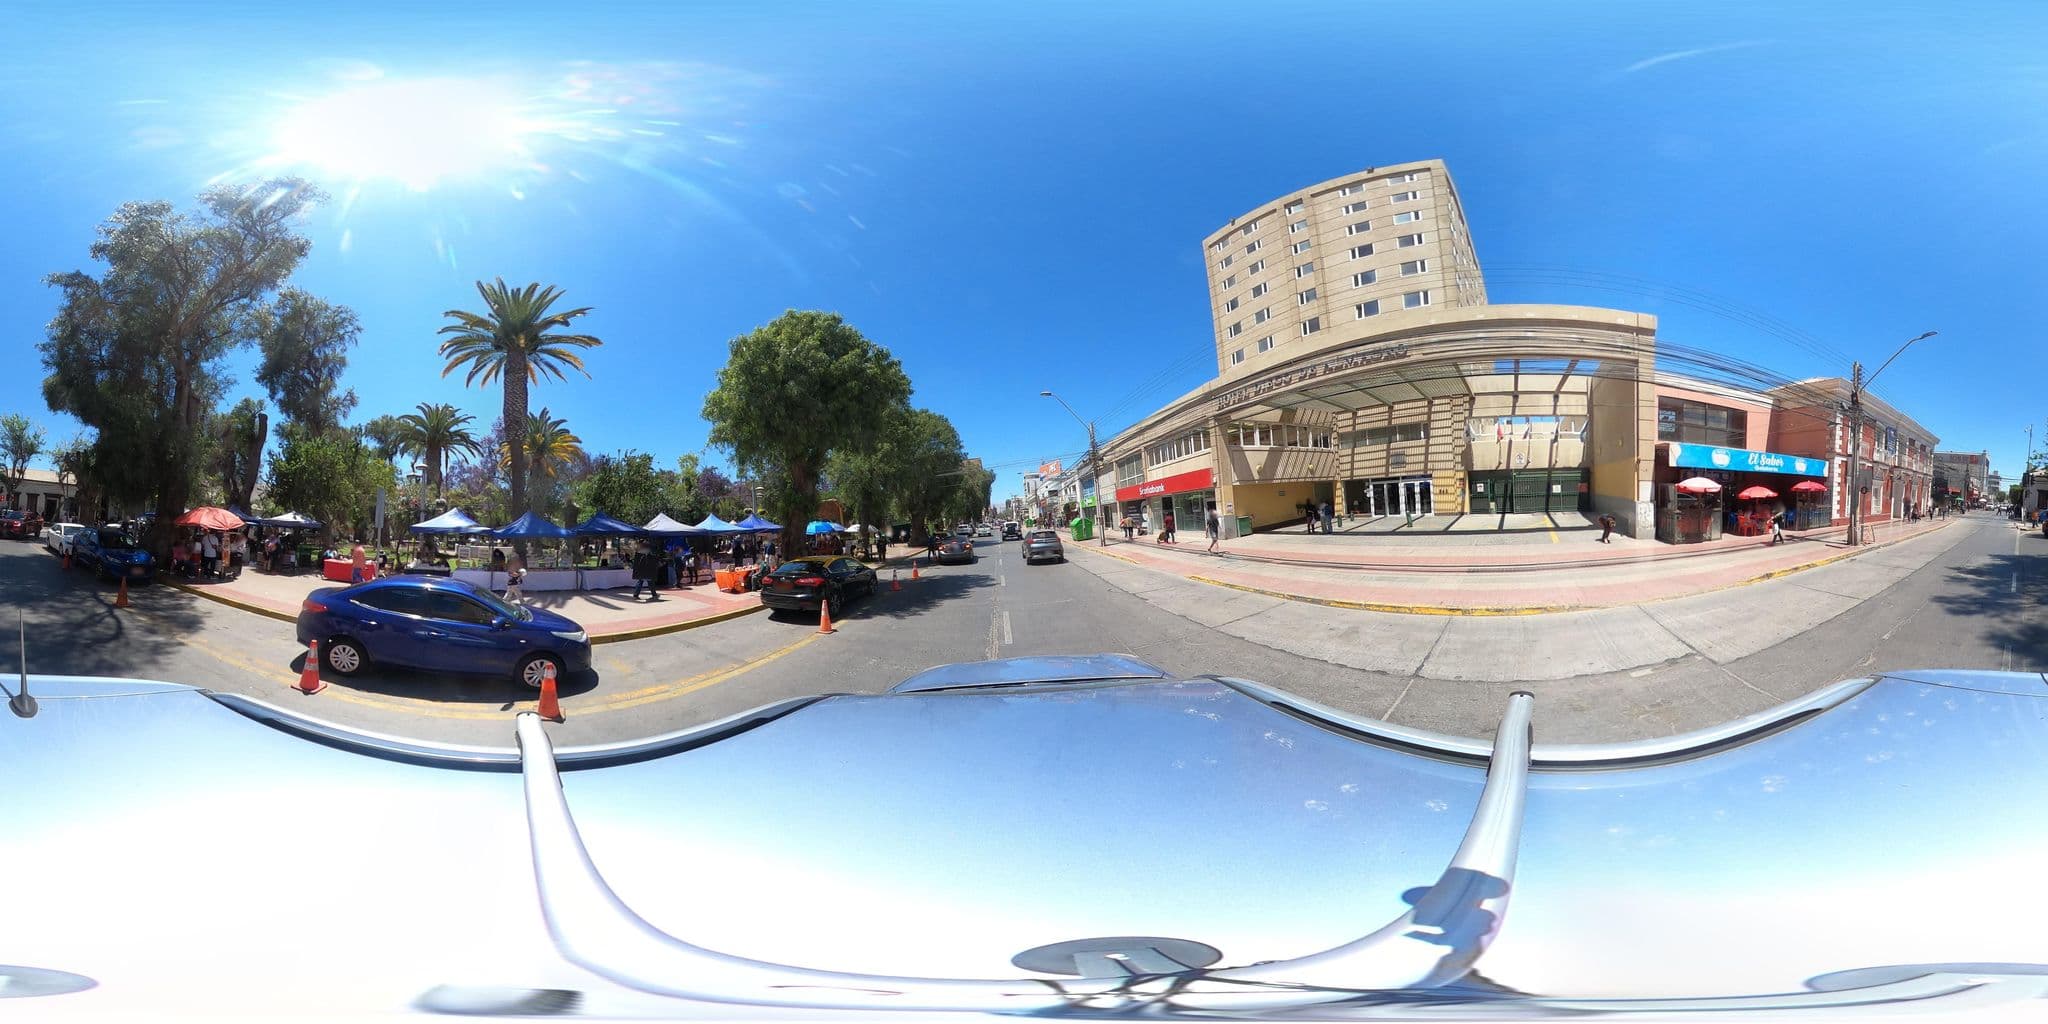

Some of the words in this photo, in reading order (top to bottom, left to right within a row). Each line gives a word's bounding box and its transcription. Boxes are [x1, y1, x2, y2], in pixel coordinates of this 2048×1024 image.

[1748, 453, 1759, 465] El
[1760, 454, 1784, 467] Sabor
[1139, 483, 1165, 495] Scotiabank
